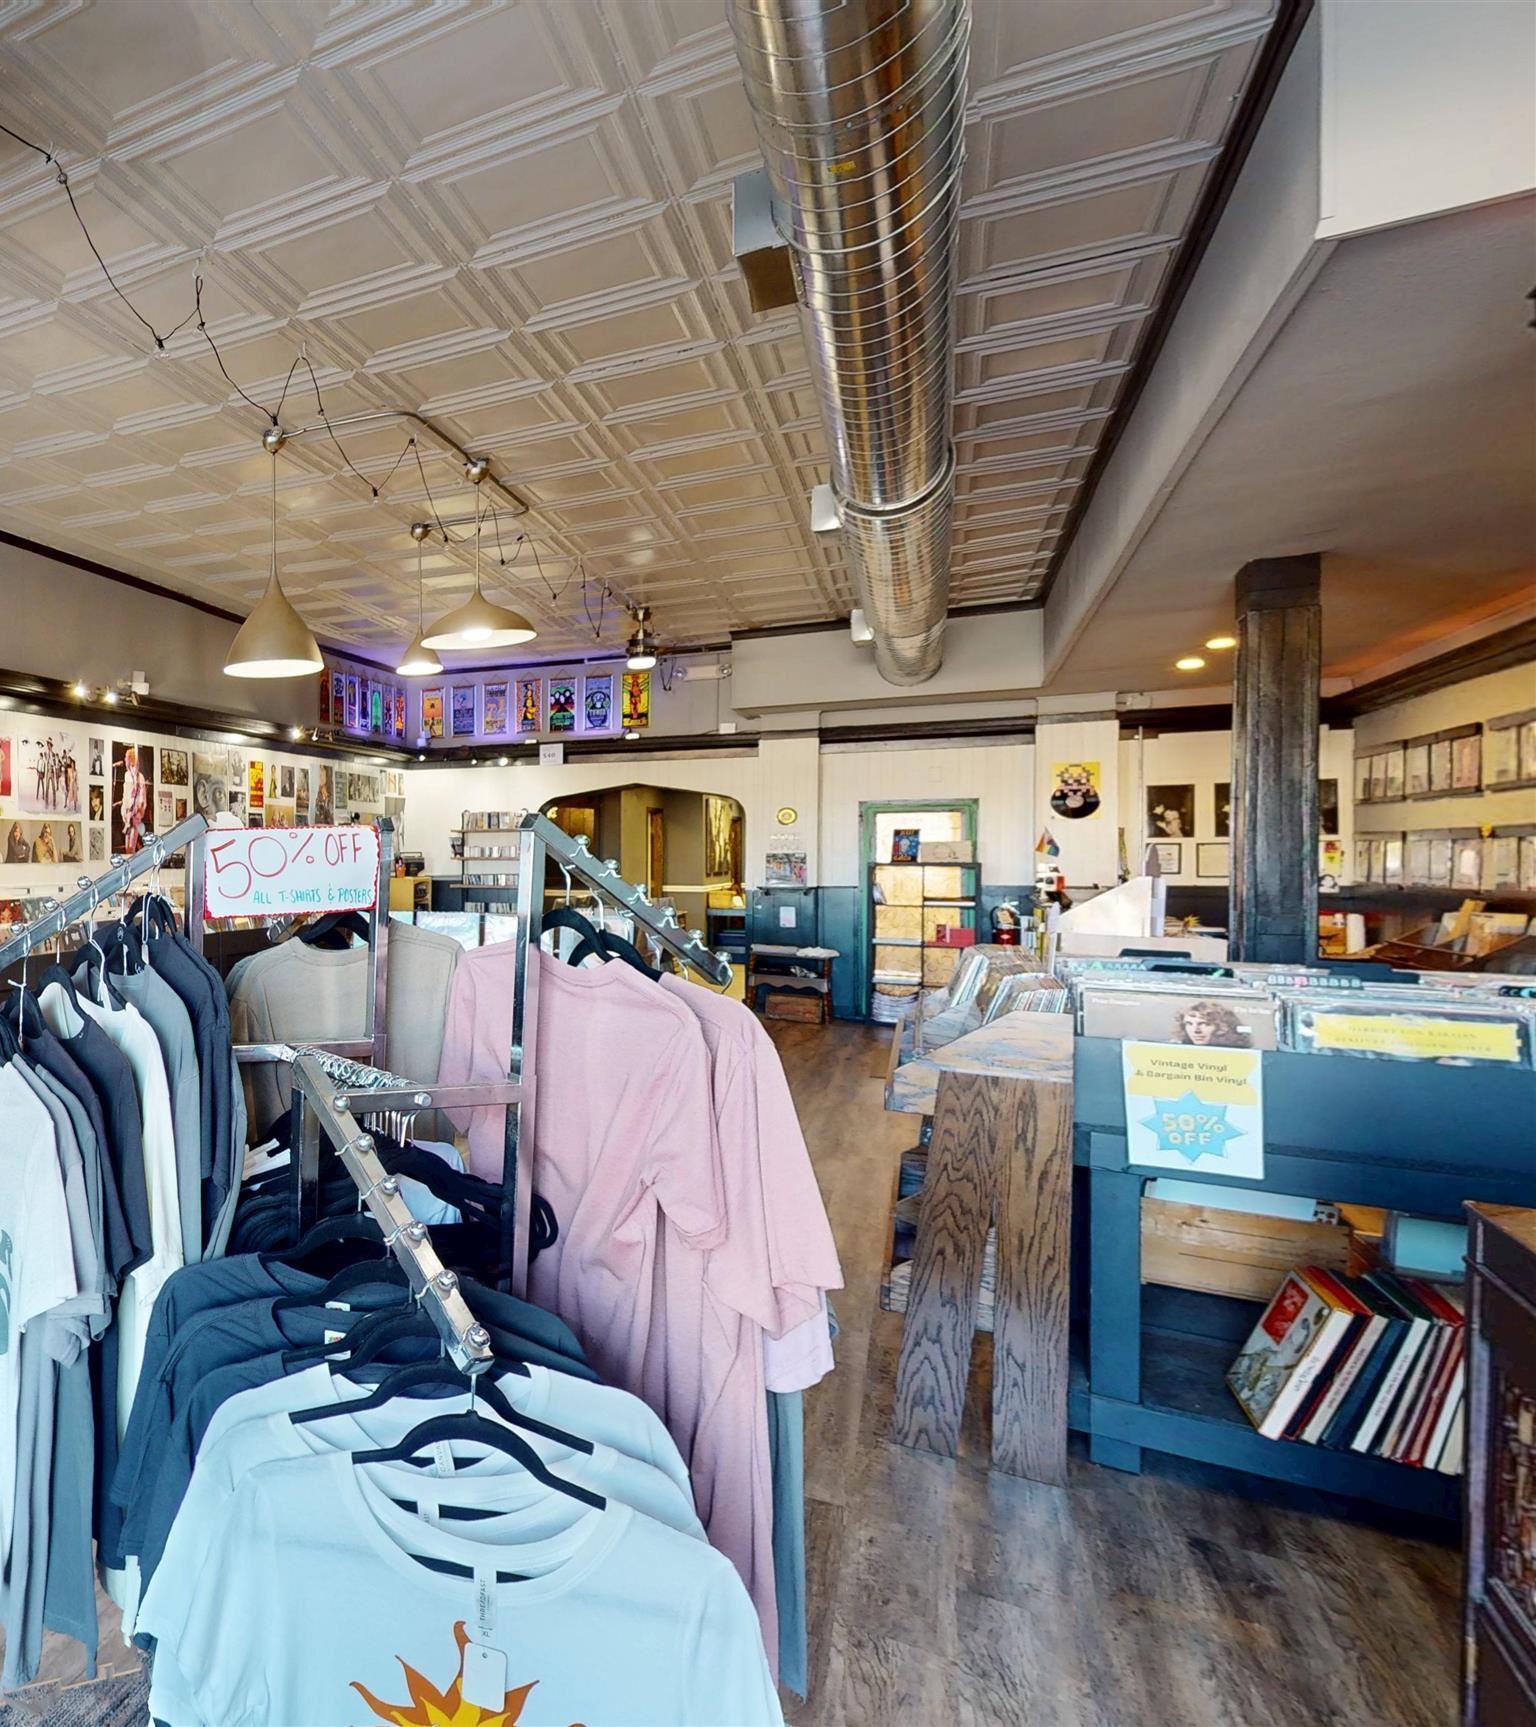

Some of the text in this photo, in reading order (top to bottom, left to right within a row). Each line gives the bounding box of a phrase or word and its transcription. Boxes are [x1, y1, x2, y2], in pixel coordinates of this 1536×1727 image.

[210, 832, 362, 899] 50% OFF
[253, 885, 372, 904] ALL T-SHIRTS & POSTERS
[1150, 1059, 1227, 1072] Vintage Vinyl
[1146, 1070, 1191, 1081] Bargain
[1194, 1074, 1214, 1083] Bin
[1216, 1077, 1247, 1086] Vinyl
[1162, 1112, 1225, 1133] 50%
[1168, 1131, 1212, 1145] OFF
